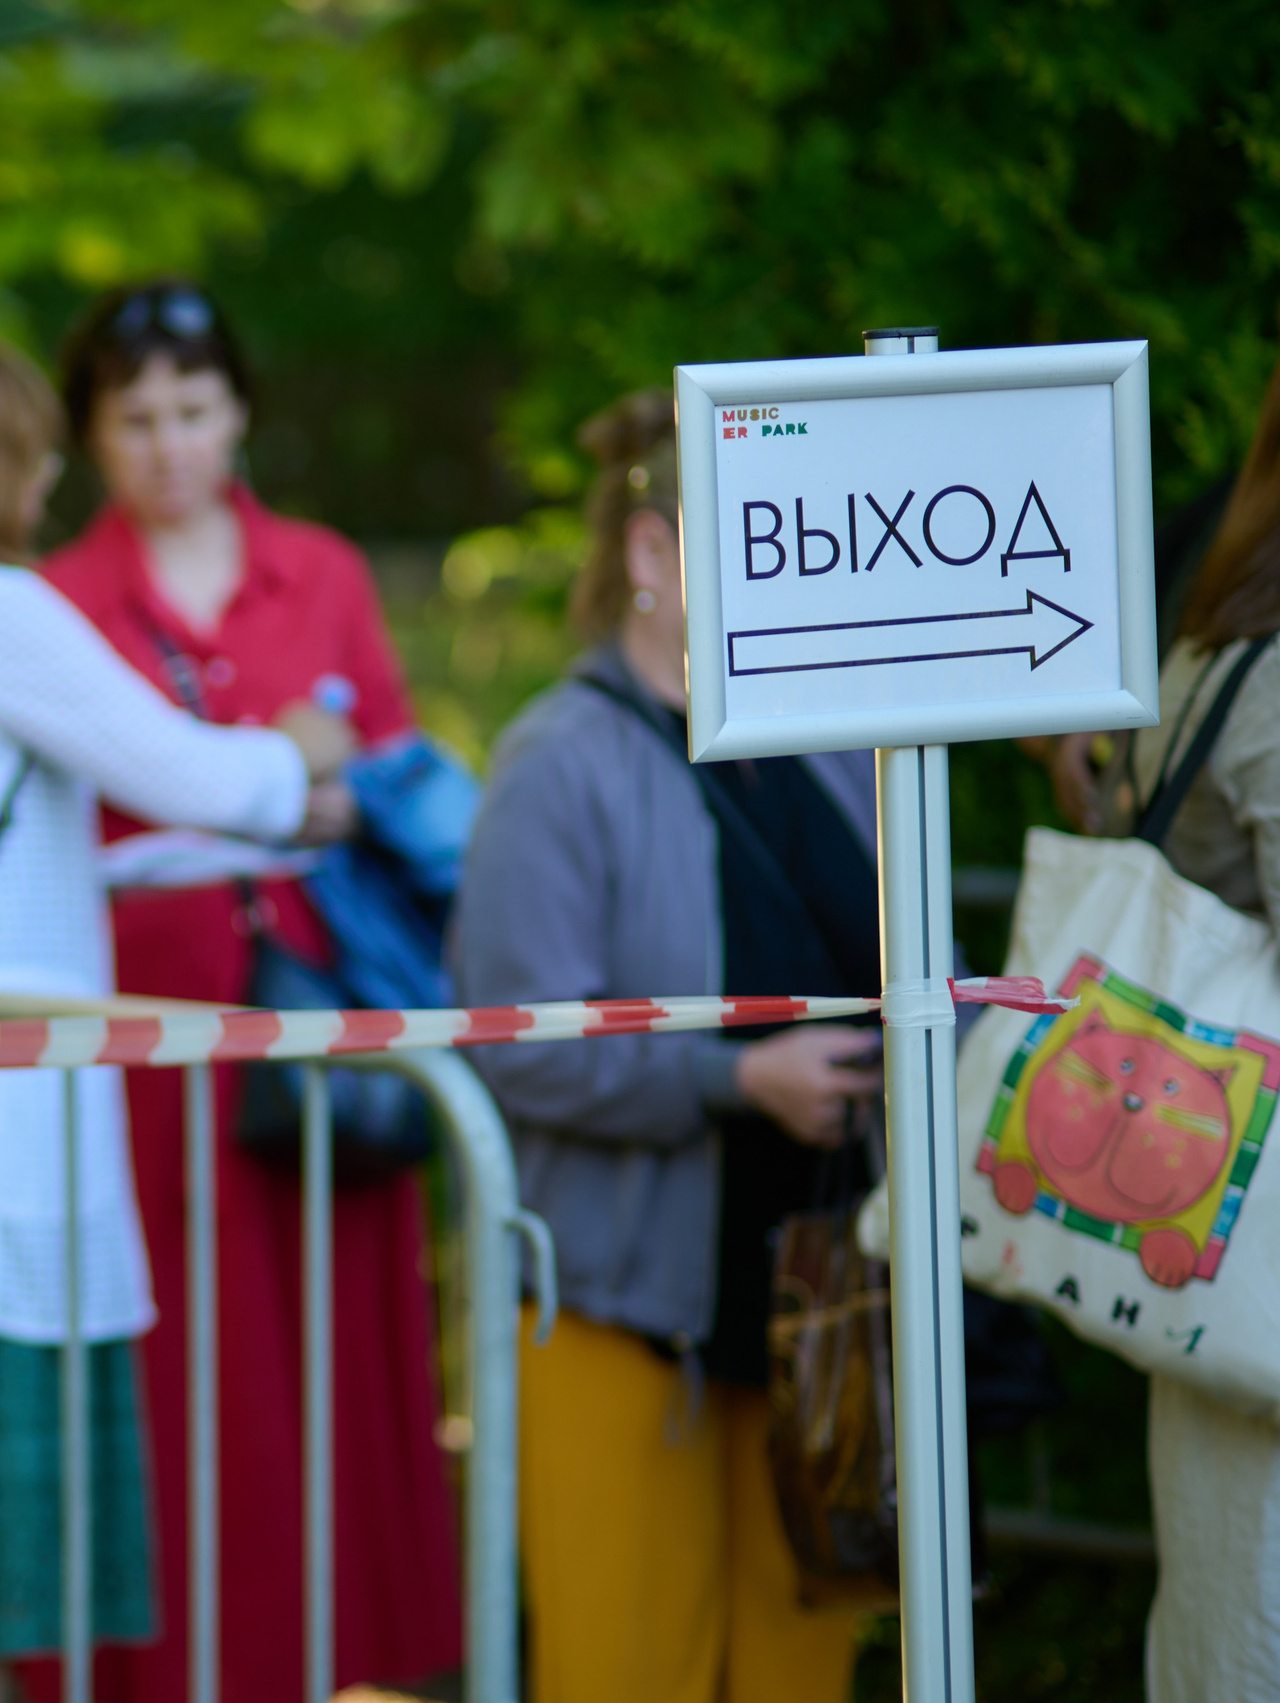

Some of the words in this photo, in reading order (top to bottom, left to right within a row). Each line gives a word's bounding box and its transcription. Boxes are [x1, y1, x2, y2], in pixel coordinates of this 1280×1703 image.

[722, 407, 779, 422] MUSIC
[723, 427, 748, 439] ER
[762, 422, 808, 437] PARK
[743, 479, 1071, 581] ВЫХОД
